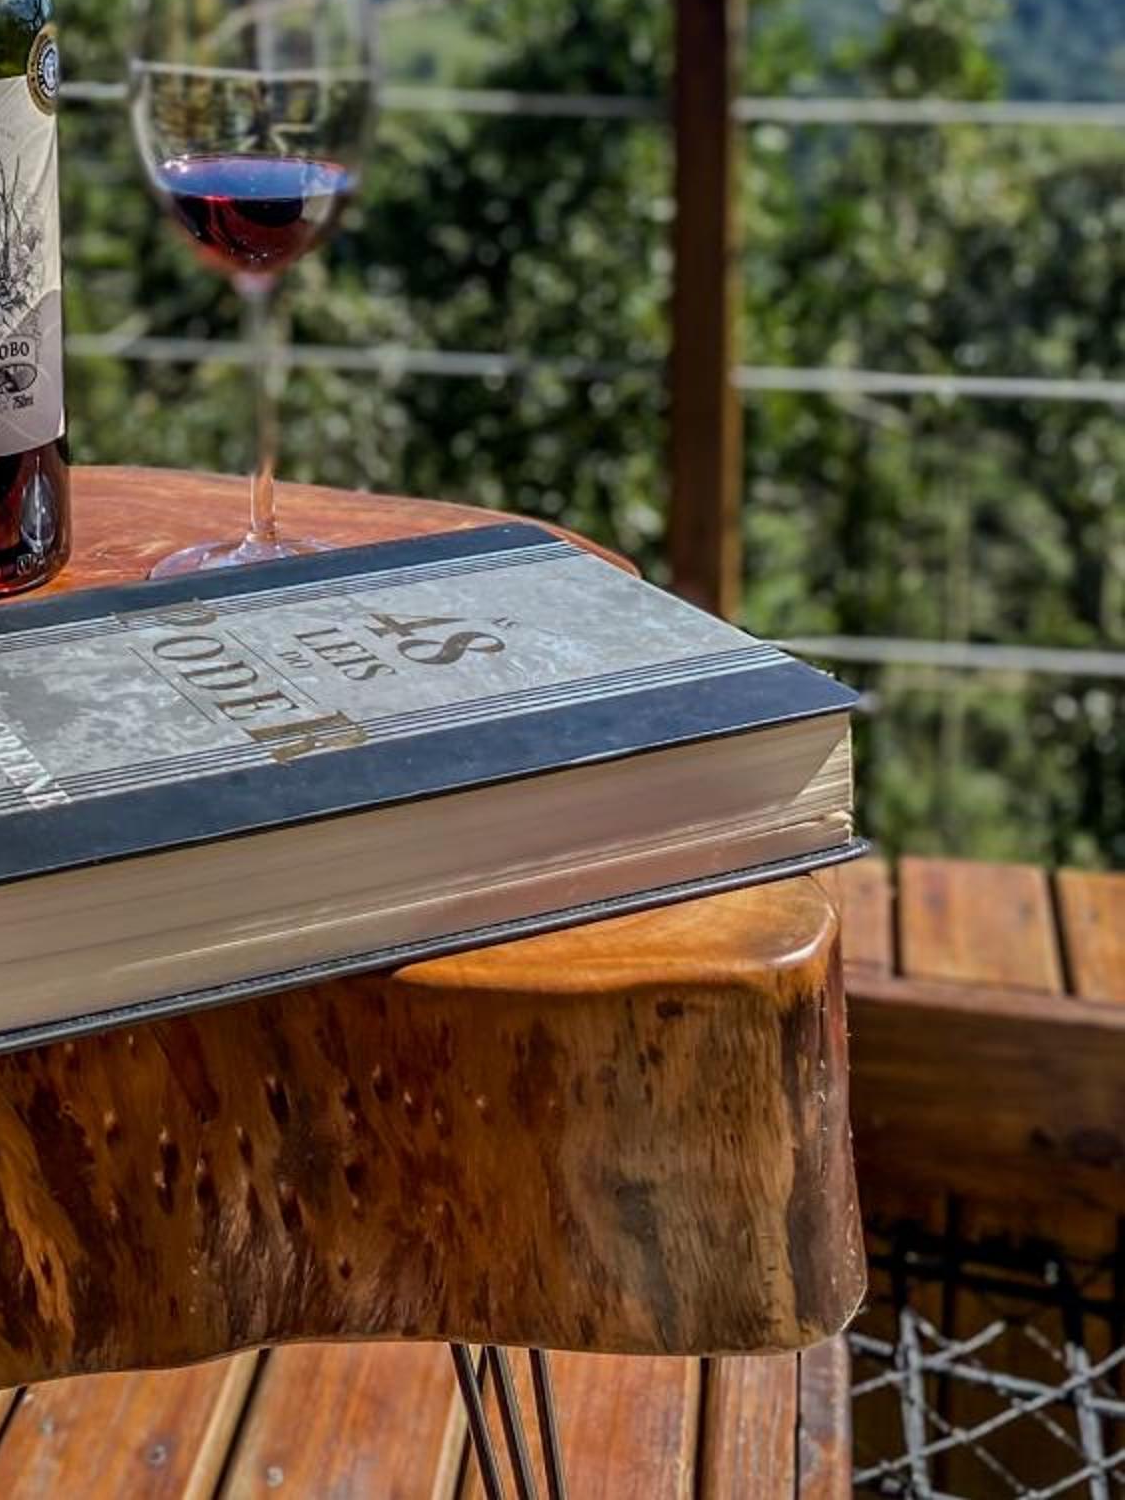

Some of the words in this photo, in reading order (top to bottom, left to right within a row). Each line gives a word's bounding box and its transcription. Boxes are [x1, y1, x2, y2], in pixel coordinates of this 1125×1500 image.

[277, 649, 313, 670] DO
[295, 627, 396, 681] LEIS
[364, 612, 506, 665] 48
[107, 598, 368, 764] PODER
